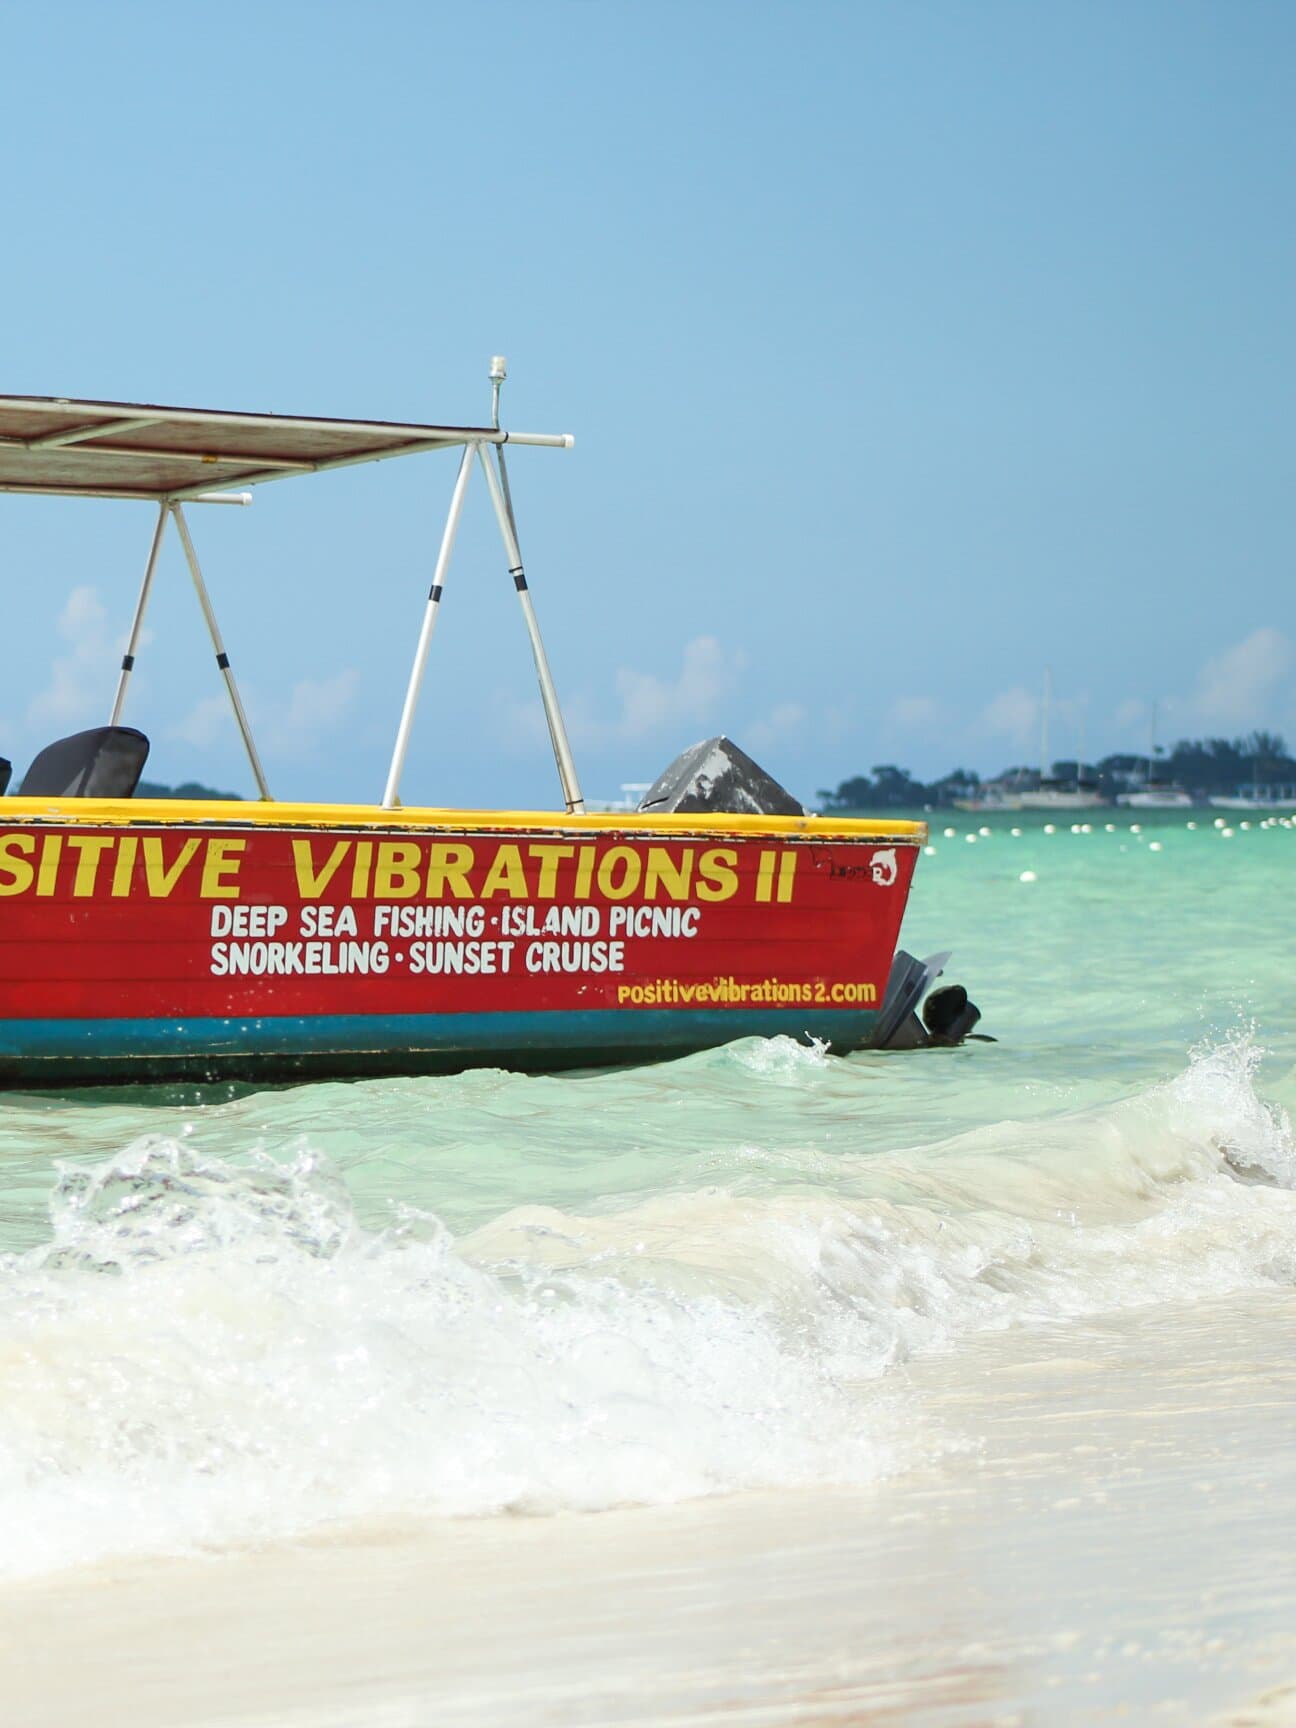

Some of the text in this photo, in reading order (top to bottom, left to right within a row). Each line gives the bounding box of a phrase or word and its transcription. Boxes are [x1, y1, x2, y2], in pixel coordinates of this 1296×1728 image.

[292, 840, 740, 902] VIBRATIONS
[754, 850, 798, 903] II
[210, 904, 701, 938] DEEP SEA FISHING ISLAND PICNIC
[210, 941, 625, 976] SNORKELING SUNSET CRUISE
